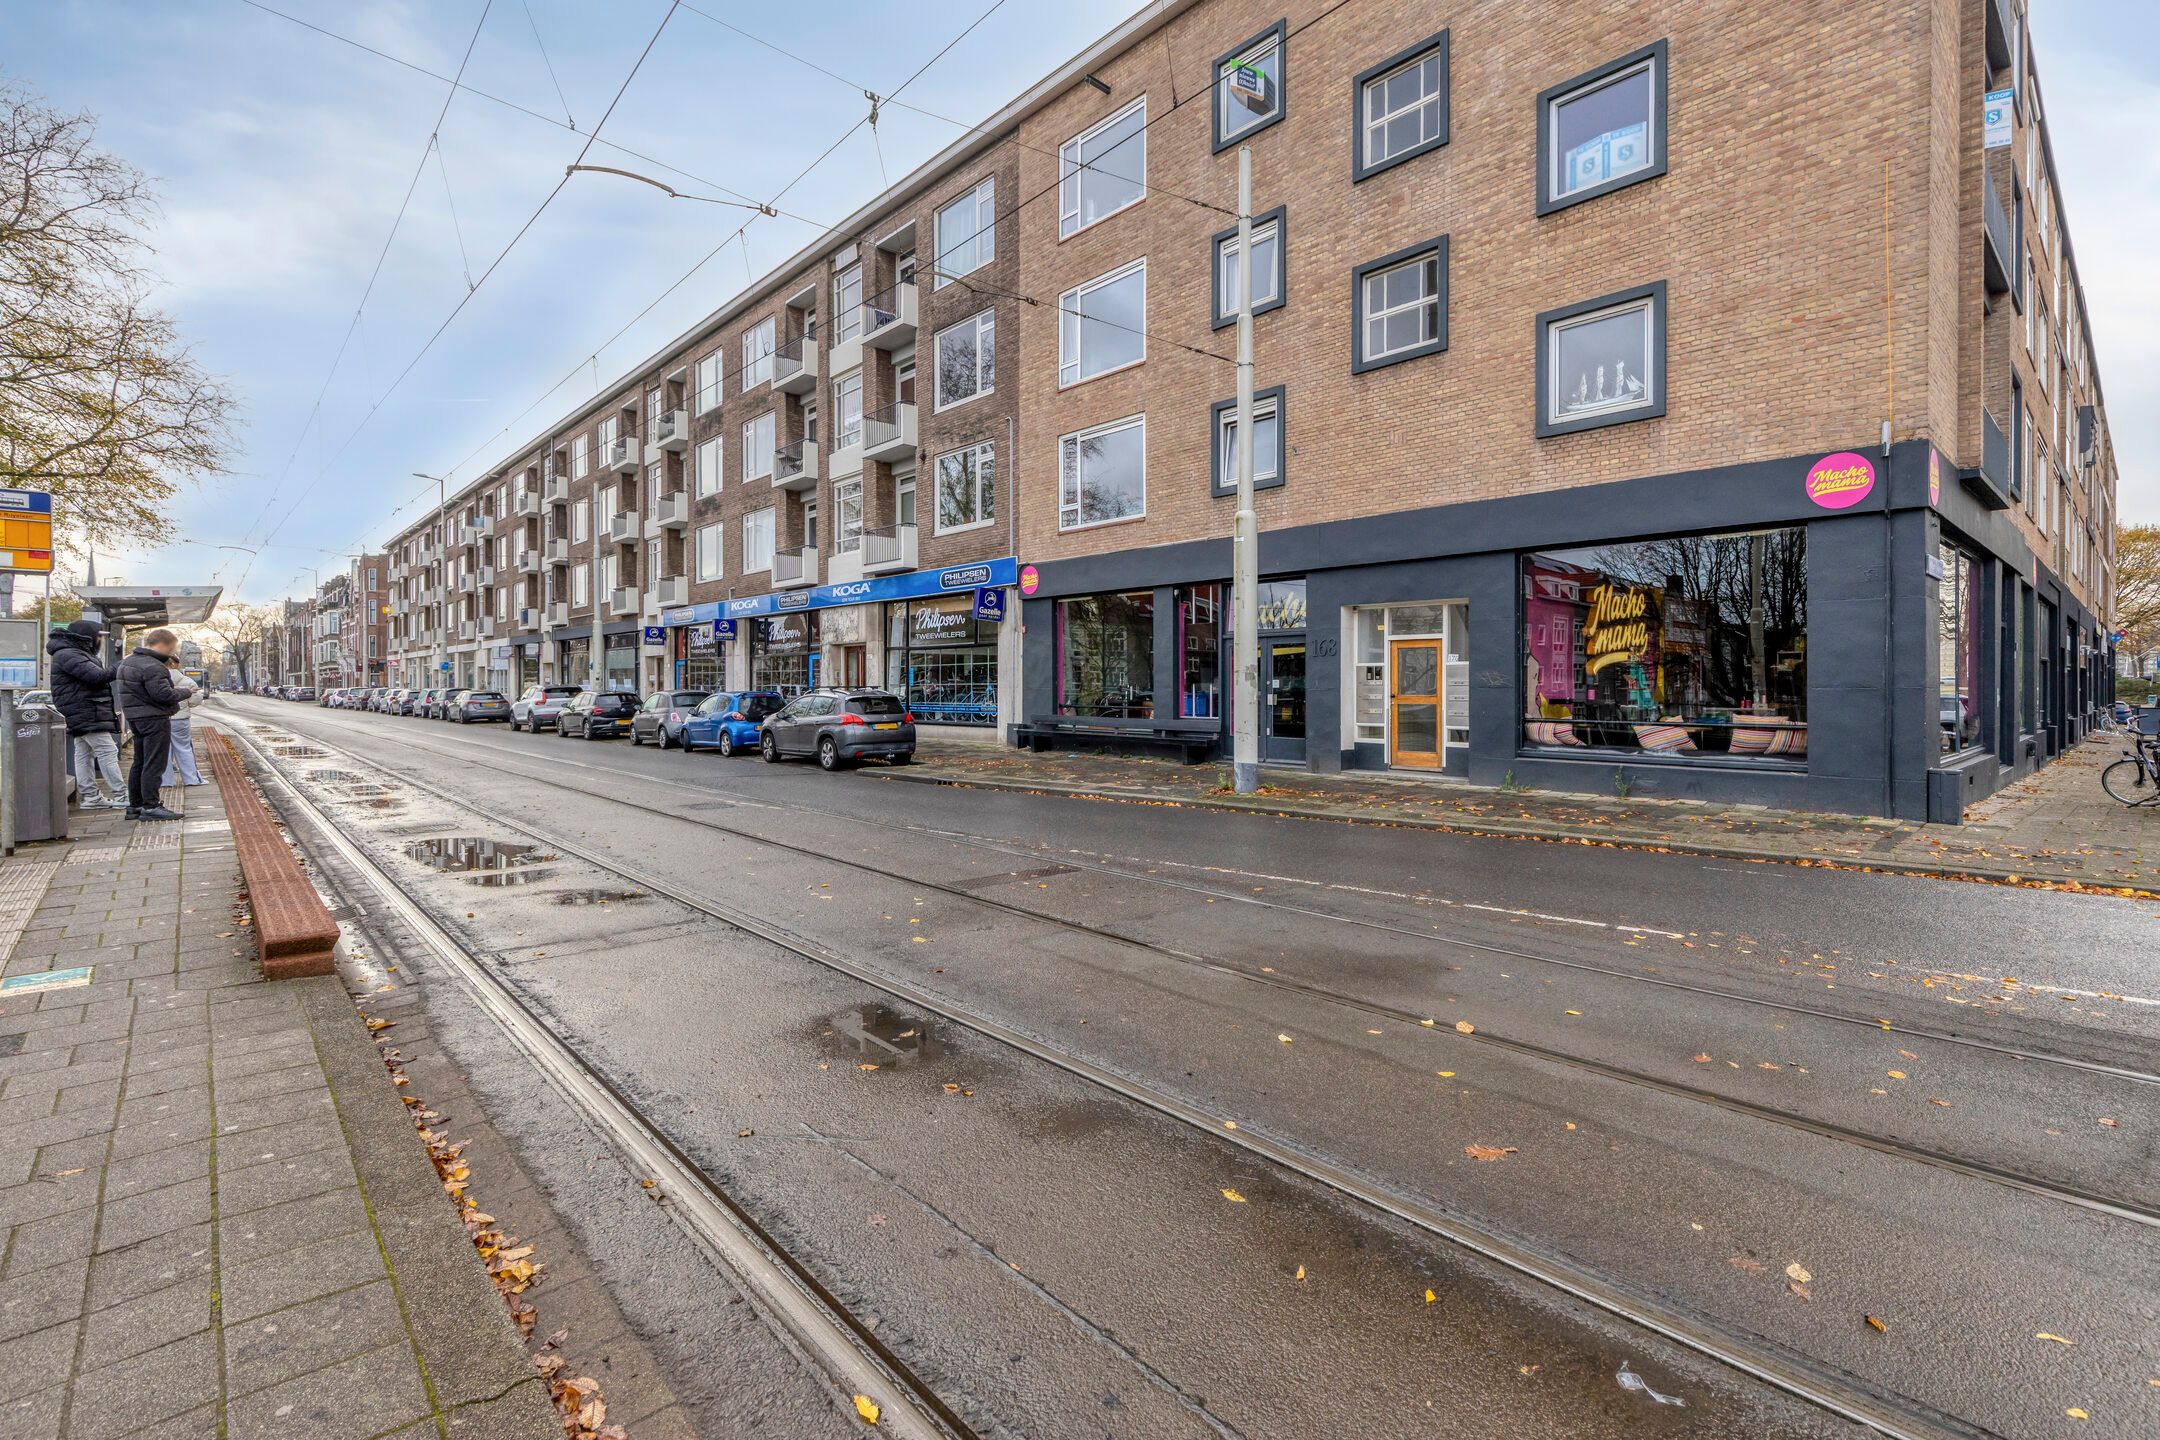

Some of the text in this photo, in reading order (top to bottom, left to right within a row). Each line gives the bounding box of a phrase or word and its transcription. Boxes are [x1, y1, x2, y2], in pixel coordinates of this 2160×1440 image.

[1989, 91, 2010, 100] KOOP
[1809, 465, 1868, 488] Macho
[1813, 474, 1870, 494] mama
[944, 568, 987, 581] PHILIPSEN
[945, 575, 987, 586] TWEEWIELERS
[832, 583, 871, 598] KOGA
[730, 599, 759, 611] KOGA
[780, 594, 807, 602] PHILIPSEN
[978, 606, 1002, 616] Gazelle
[1589, 584, 1647, 636] Macho
[915, 607, 966, 632] Philipsen
[915, 631, 967, 640] TWEEWIELERS
[1593, 622, 1648, 656] mama
[1311, 638, 1338, 658] 168
